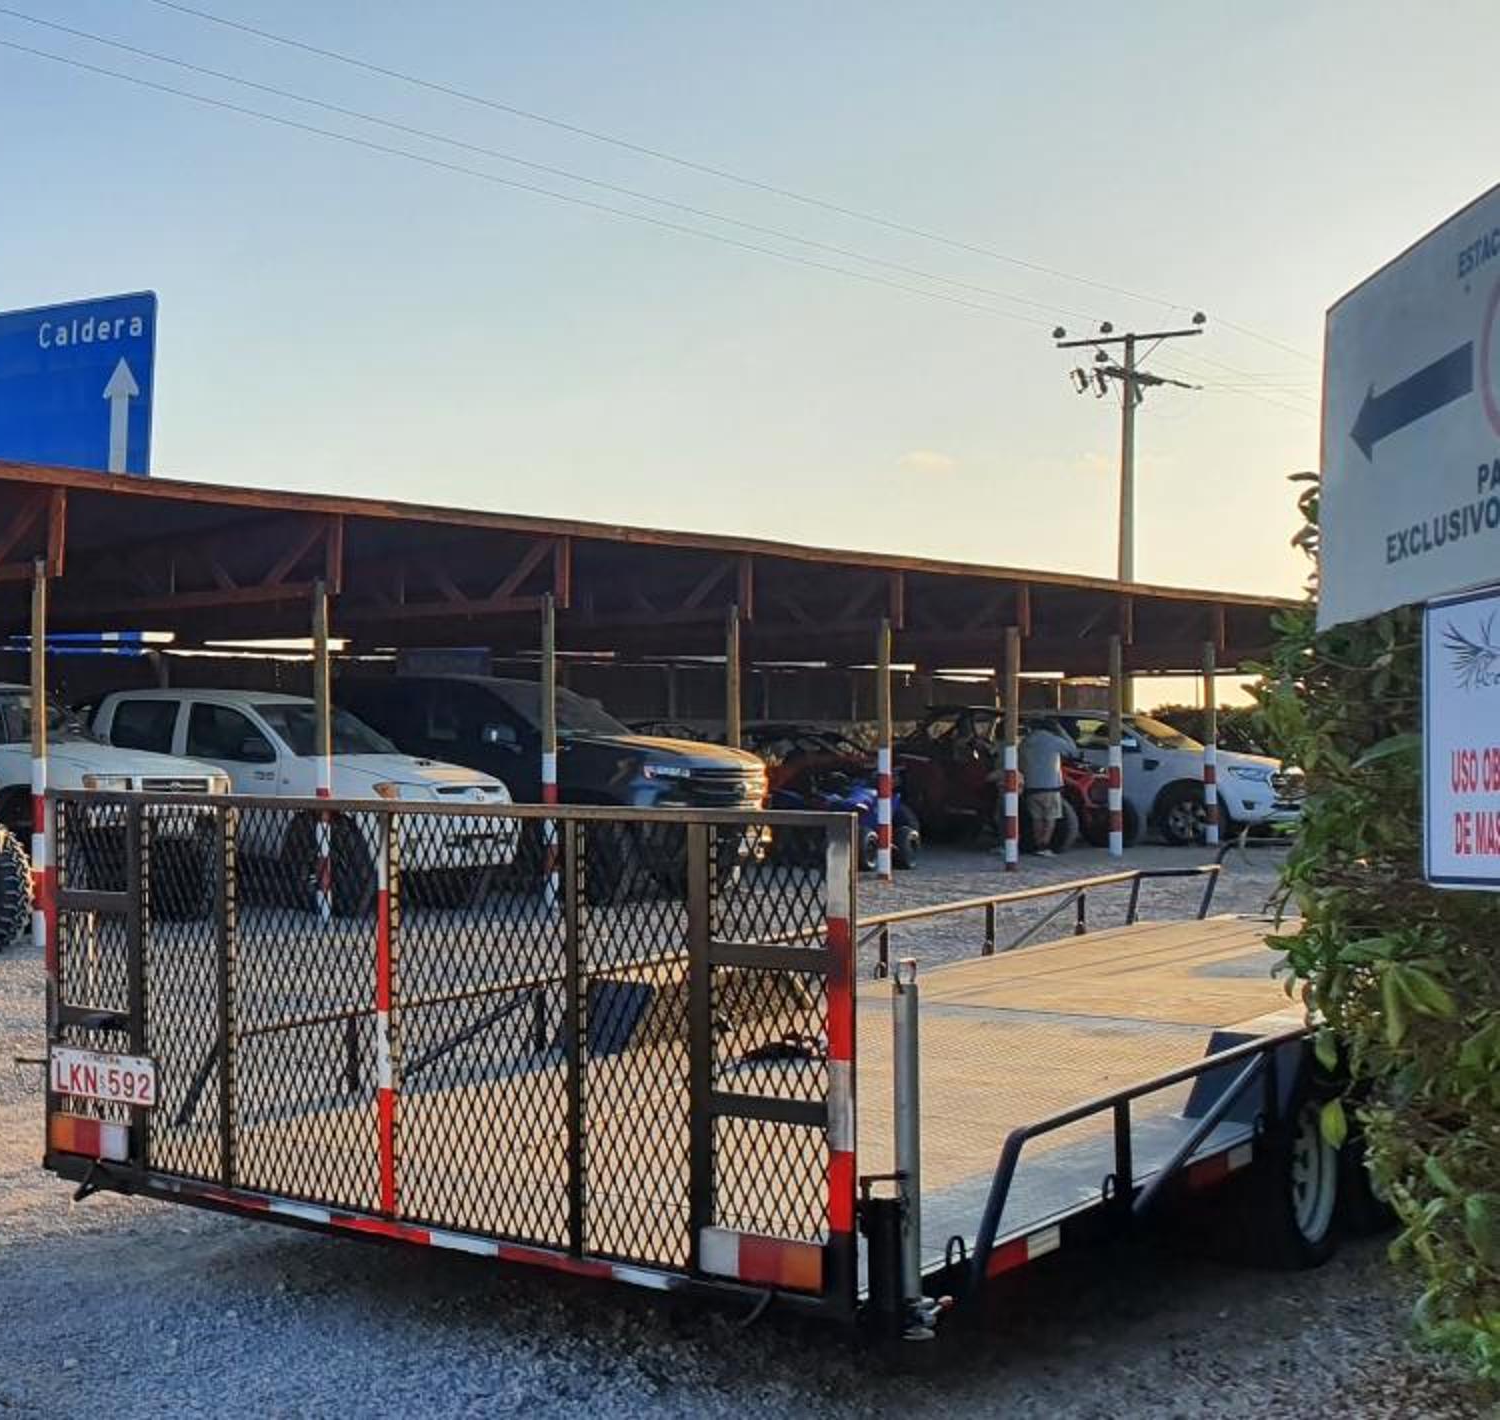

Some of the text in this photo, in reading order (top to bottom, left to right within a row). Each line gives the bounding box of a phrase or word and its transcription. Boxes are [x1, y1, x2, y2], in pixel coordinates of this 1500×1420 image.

[39, 316, 143, 349] Caldera
[1385, 496, 1500, 565] EXCLUSIVO
[1451, 747, 1500, 793] USO OB
[1455, 811, 1472, 855] DE
[57, 1060, 150, 1101] LKN 592
